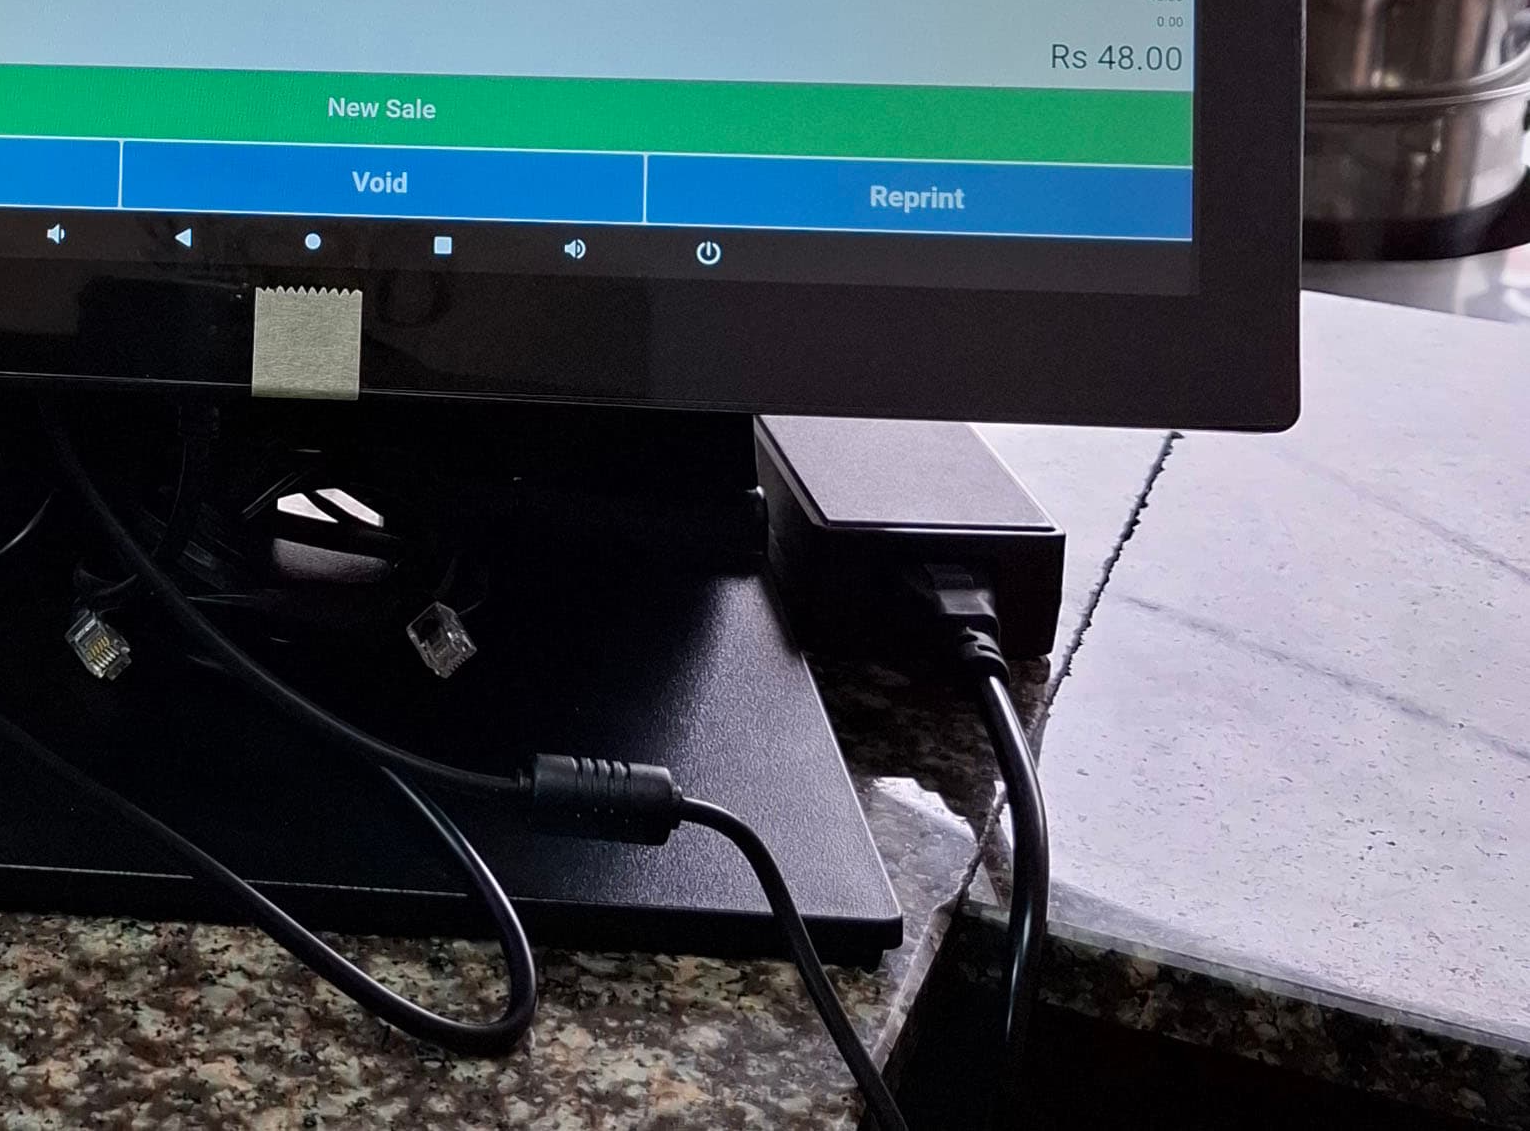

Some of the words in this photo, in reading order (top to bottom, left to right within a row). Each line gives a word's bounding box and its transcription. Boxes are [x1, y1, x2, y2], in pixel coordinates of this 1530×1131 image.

[1156, 15, 1184, 28] 0.00
[1051, 44, 1088, 70] Rs
[1098, 44, 1183, 71] 48.00
[328, 97, 380, 118] New
[386, 98, 437, 119] Sale
[352, 170, 408, 195] Void
[870, 184, 966, 215] Reprint
